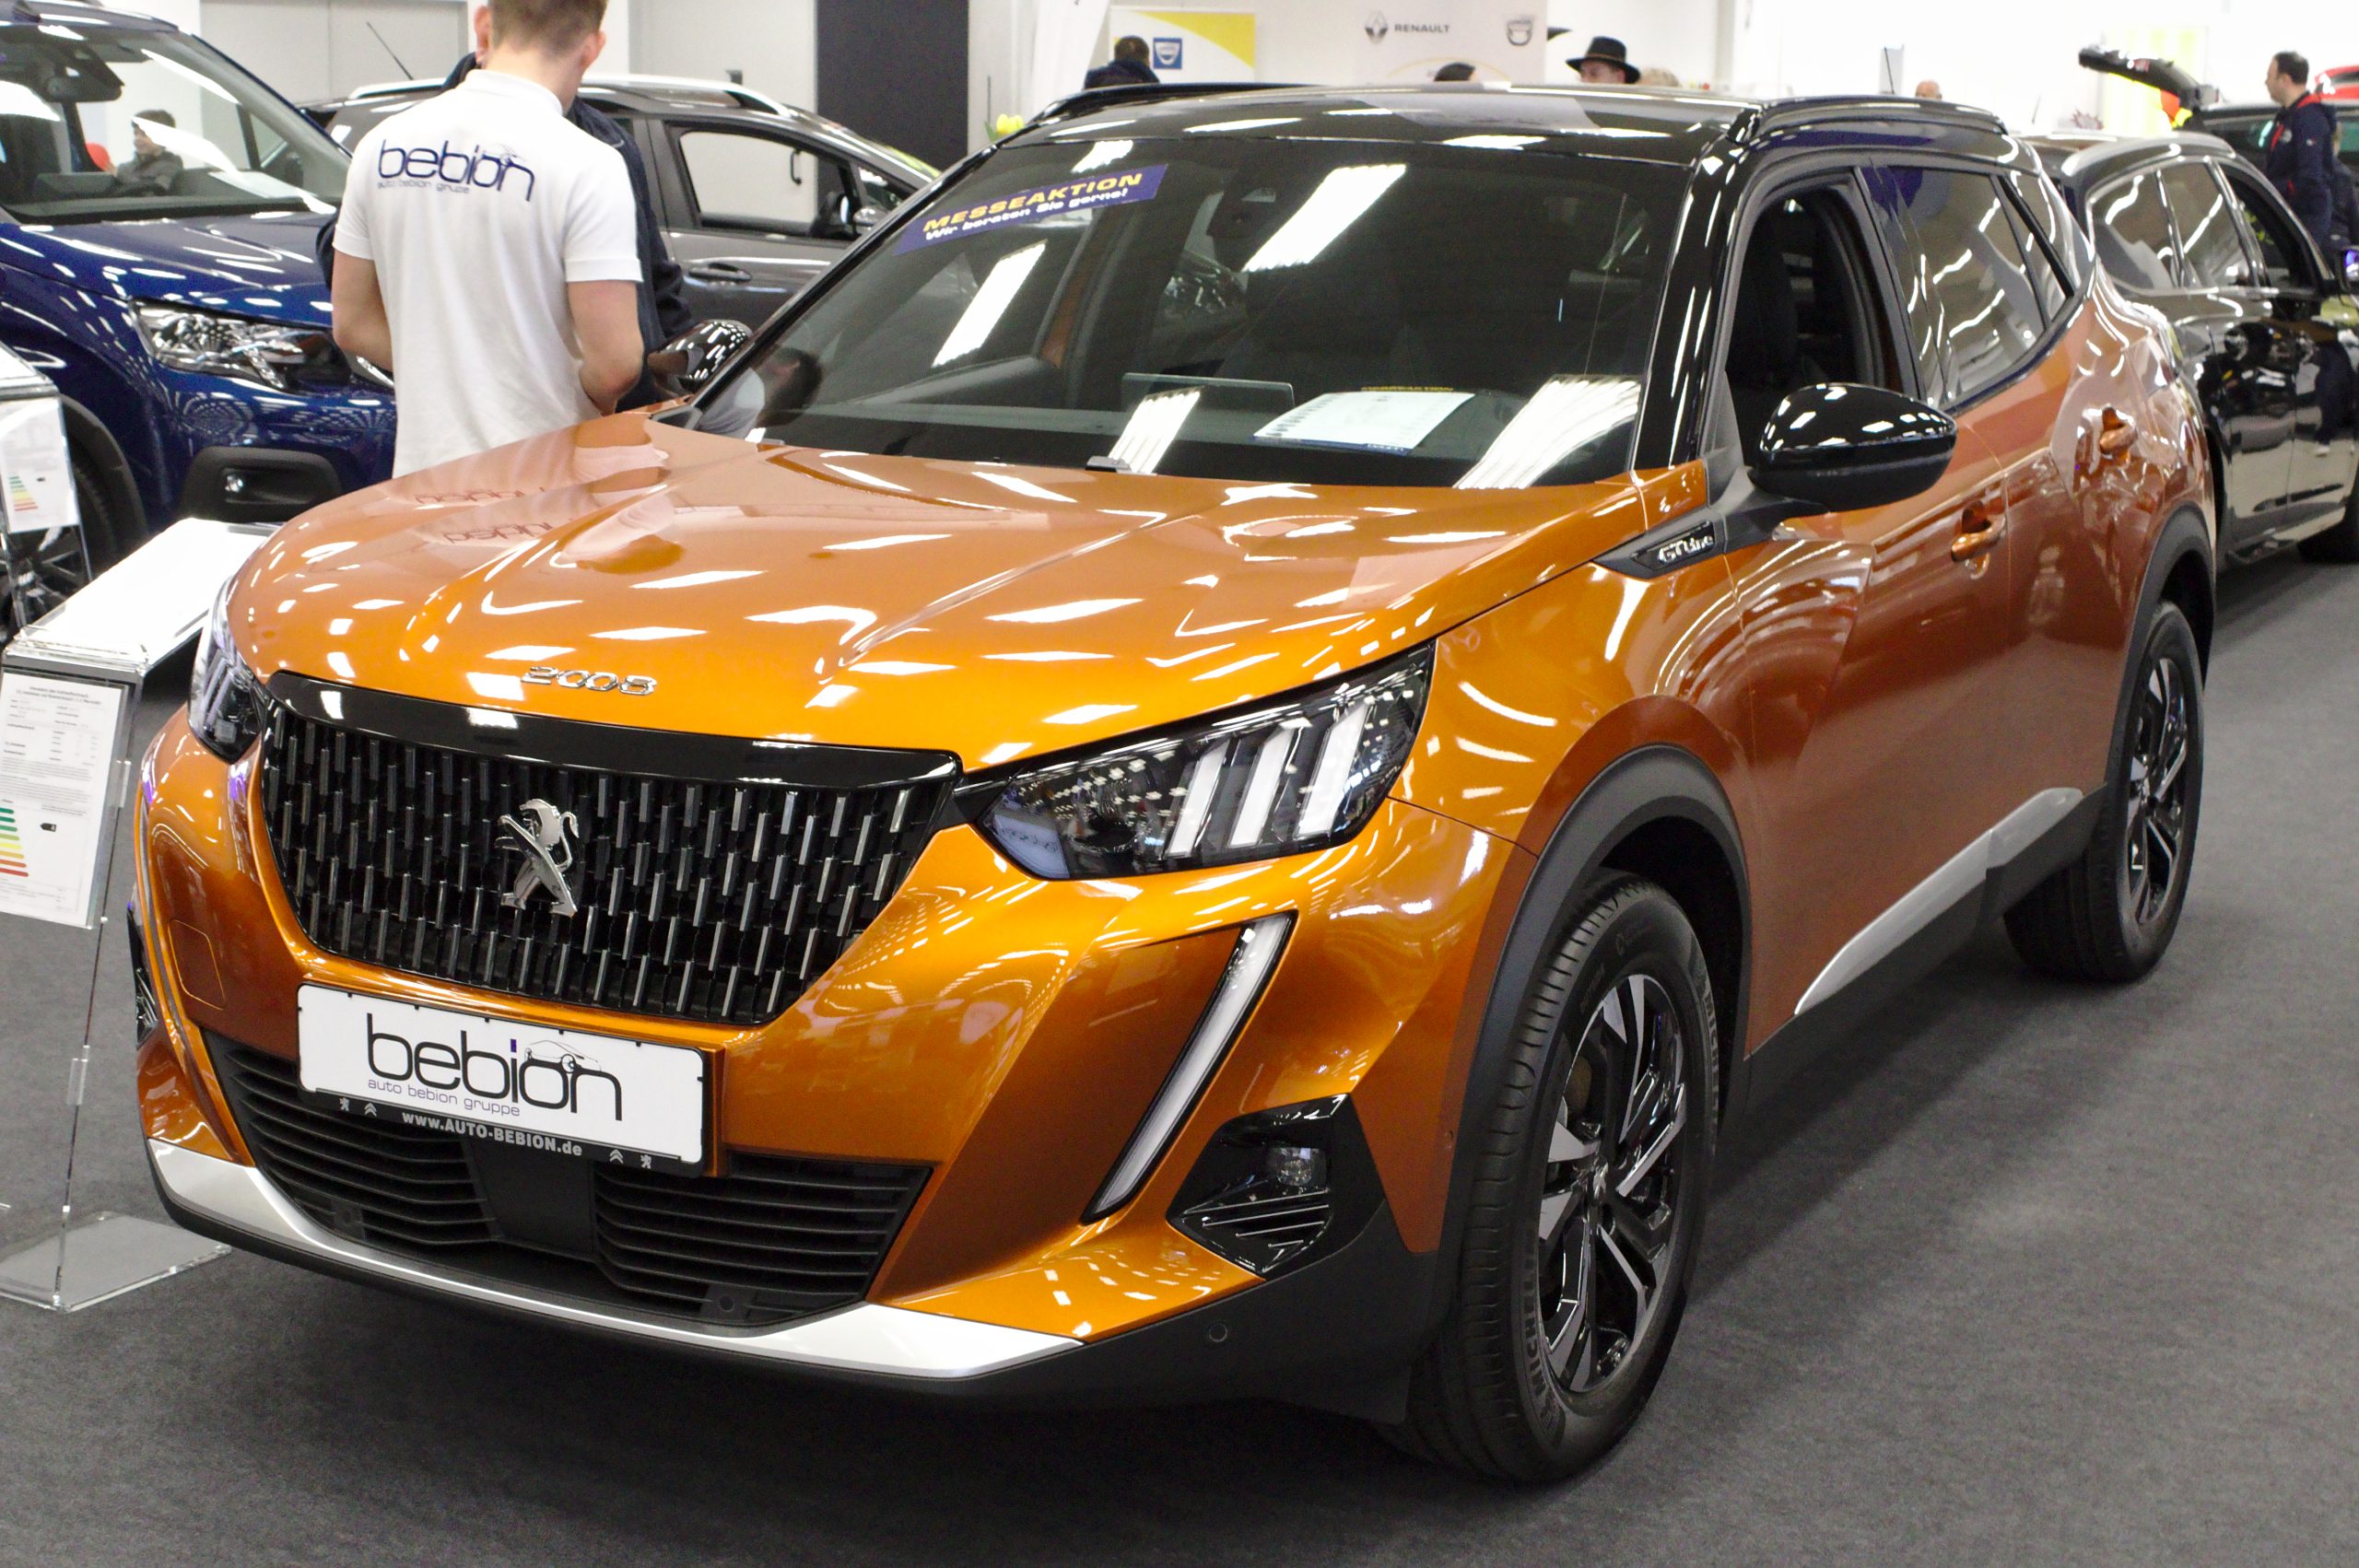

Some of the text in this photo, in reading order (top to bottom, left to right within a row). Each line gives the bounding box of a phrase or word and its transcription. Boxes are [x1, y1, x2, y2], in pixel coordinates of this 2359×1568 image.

[1393, 23, 1450, 34] RENAULT
[378, 139, 534, 202] bebion
[922, 173, 1143, 232] MESSEAKTION
[925, 188, 1129, 241] Wir beraten Sie gerne!
[521, 666, 658, 696] 2008
[366, 1012, 622, 1121] bebion
[368, 1079, 521, 1117] auto bebion gruppe
[402, 1111, 582, 1157] www.AUTO-BEBION.de
